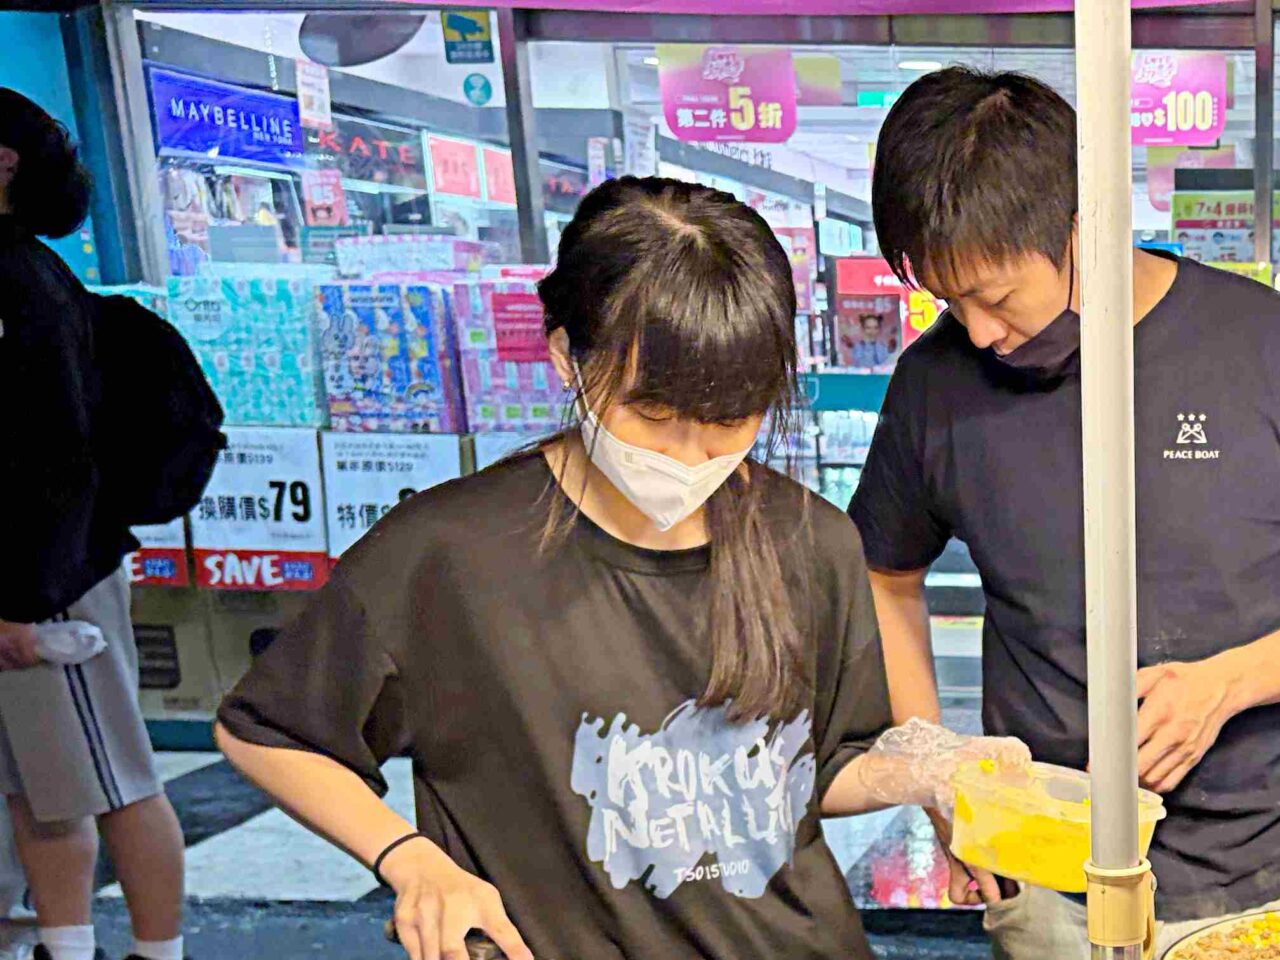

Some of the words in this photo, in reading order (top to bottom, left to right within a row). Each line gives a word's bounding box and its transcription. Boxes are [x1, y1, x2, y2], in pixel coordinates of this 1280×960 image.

[171, 97, 293, 138] MAYBELLINE
[318, 131, 416, 164] KATE
[1163, 450, 1193, 459] PEACE
[1195, 450, 1220, 459] BOAT
[204, 553, 285, 586] SAVE
[607, 734, 787, 808] KROKUS
